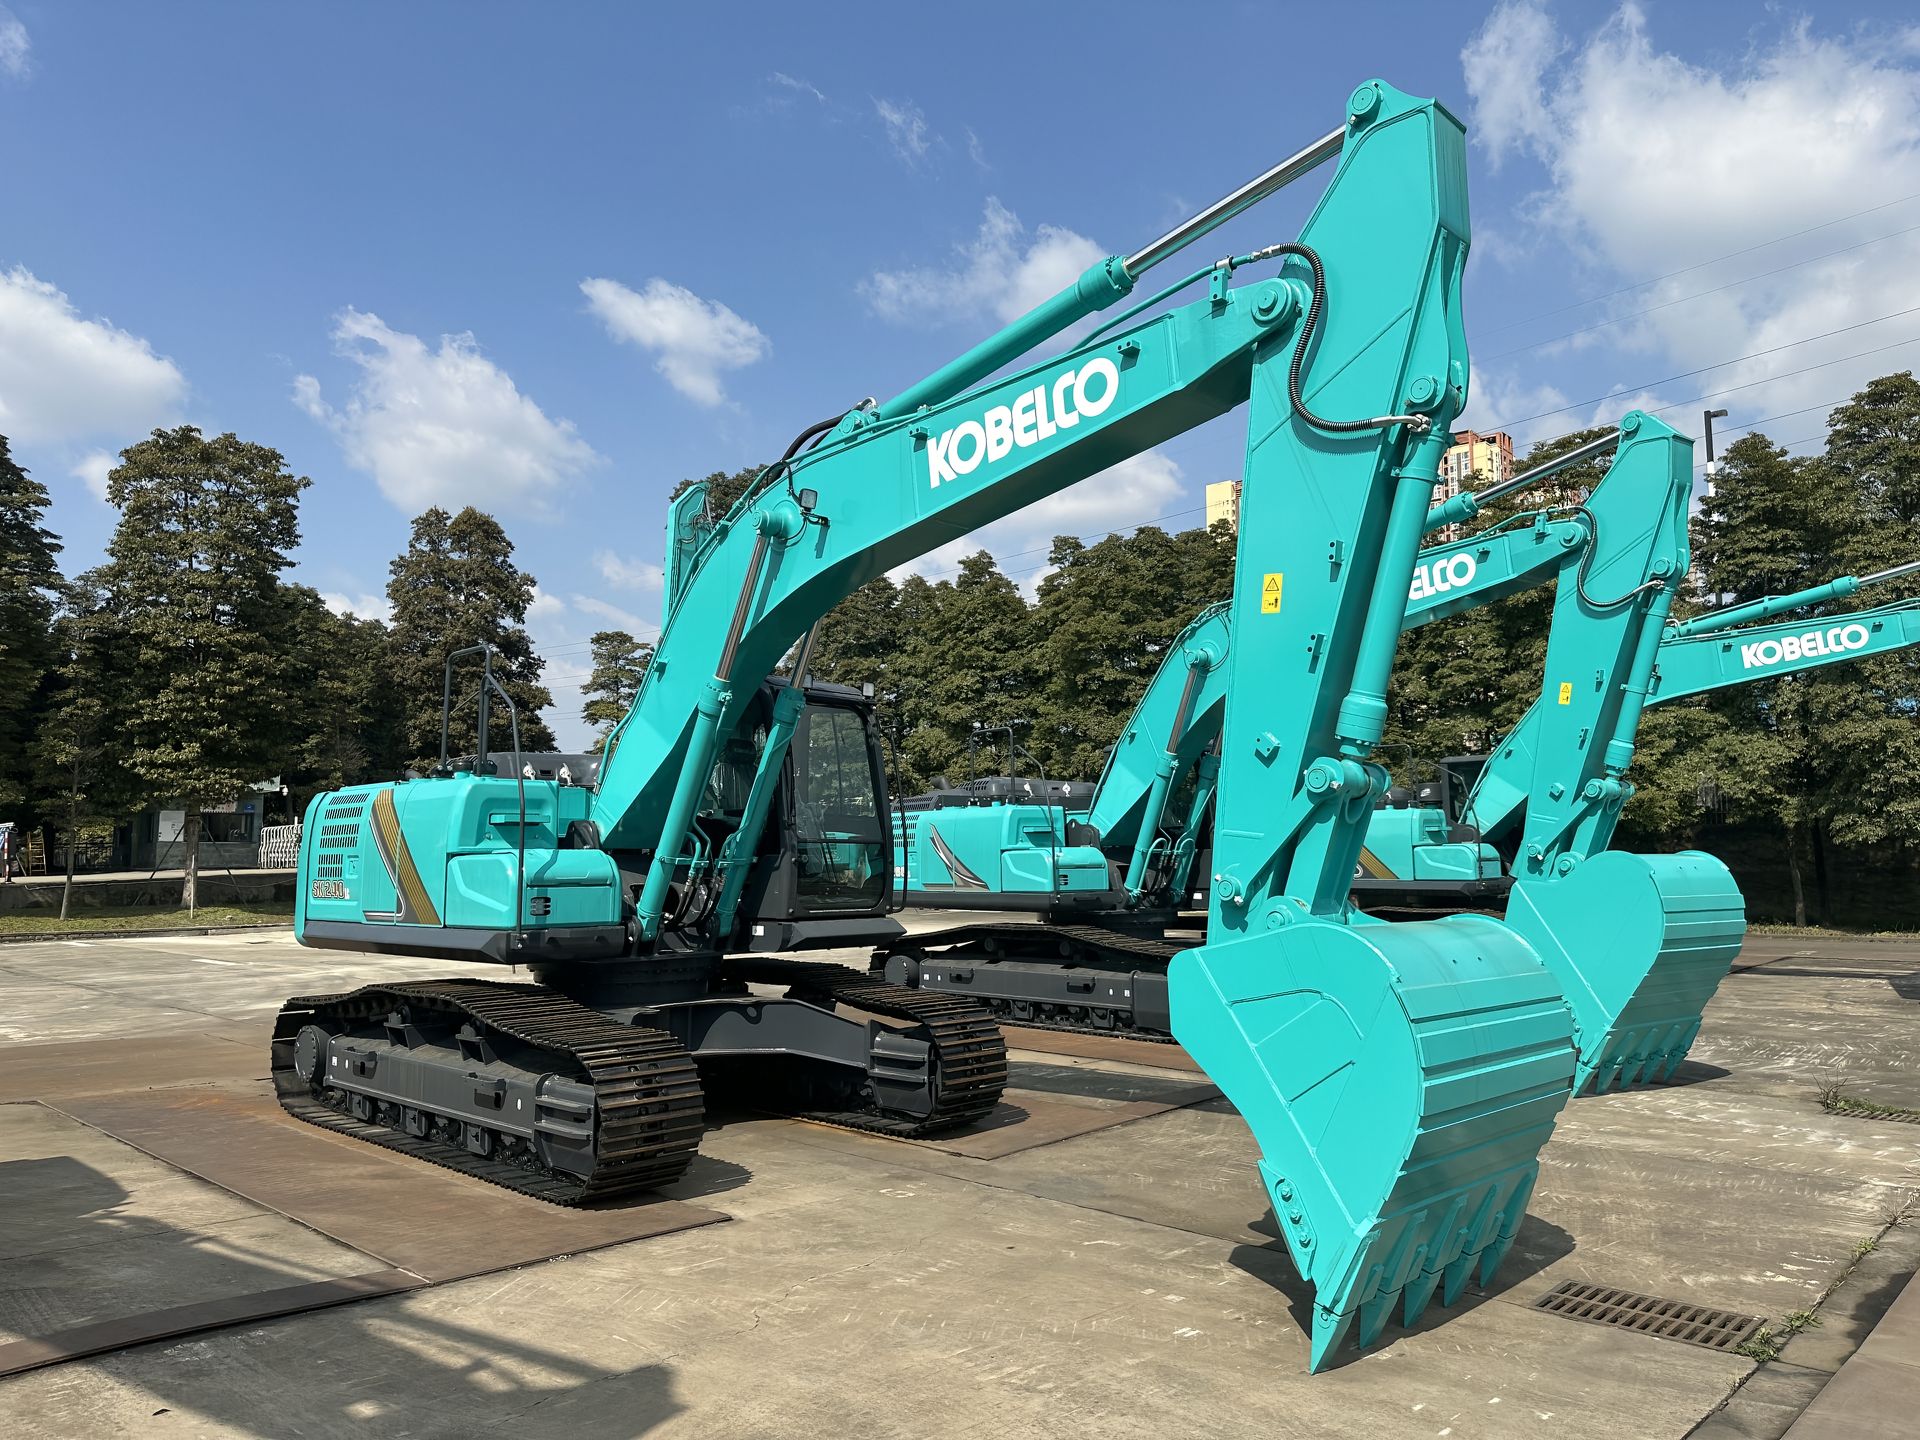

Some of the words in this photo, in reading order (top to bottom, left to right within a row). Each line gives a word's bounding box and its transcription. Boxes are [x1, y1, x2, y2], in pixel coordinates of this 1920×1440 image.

[927, 357, 1119, 489] KOBELCO
[1408, 553, 1476, 600] ELCO
[1741, 624, 1869, 669] KOBELCO
